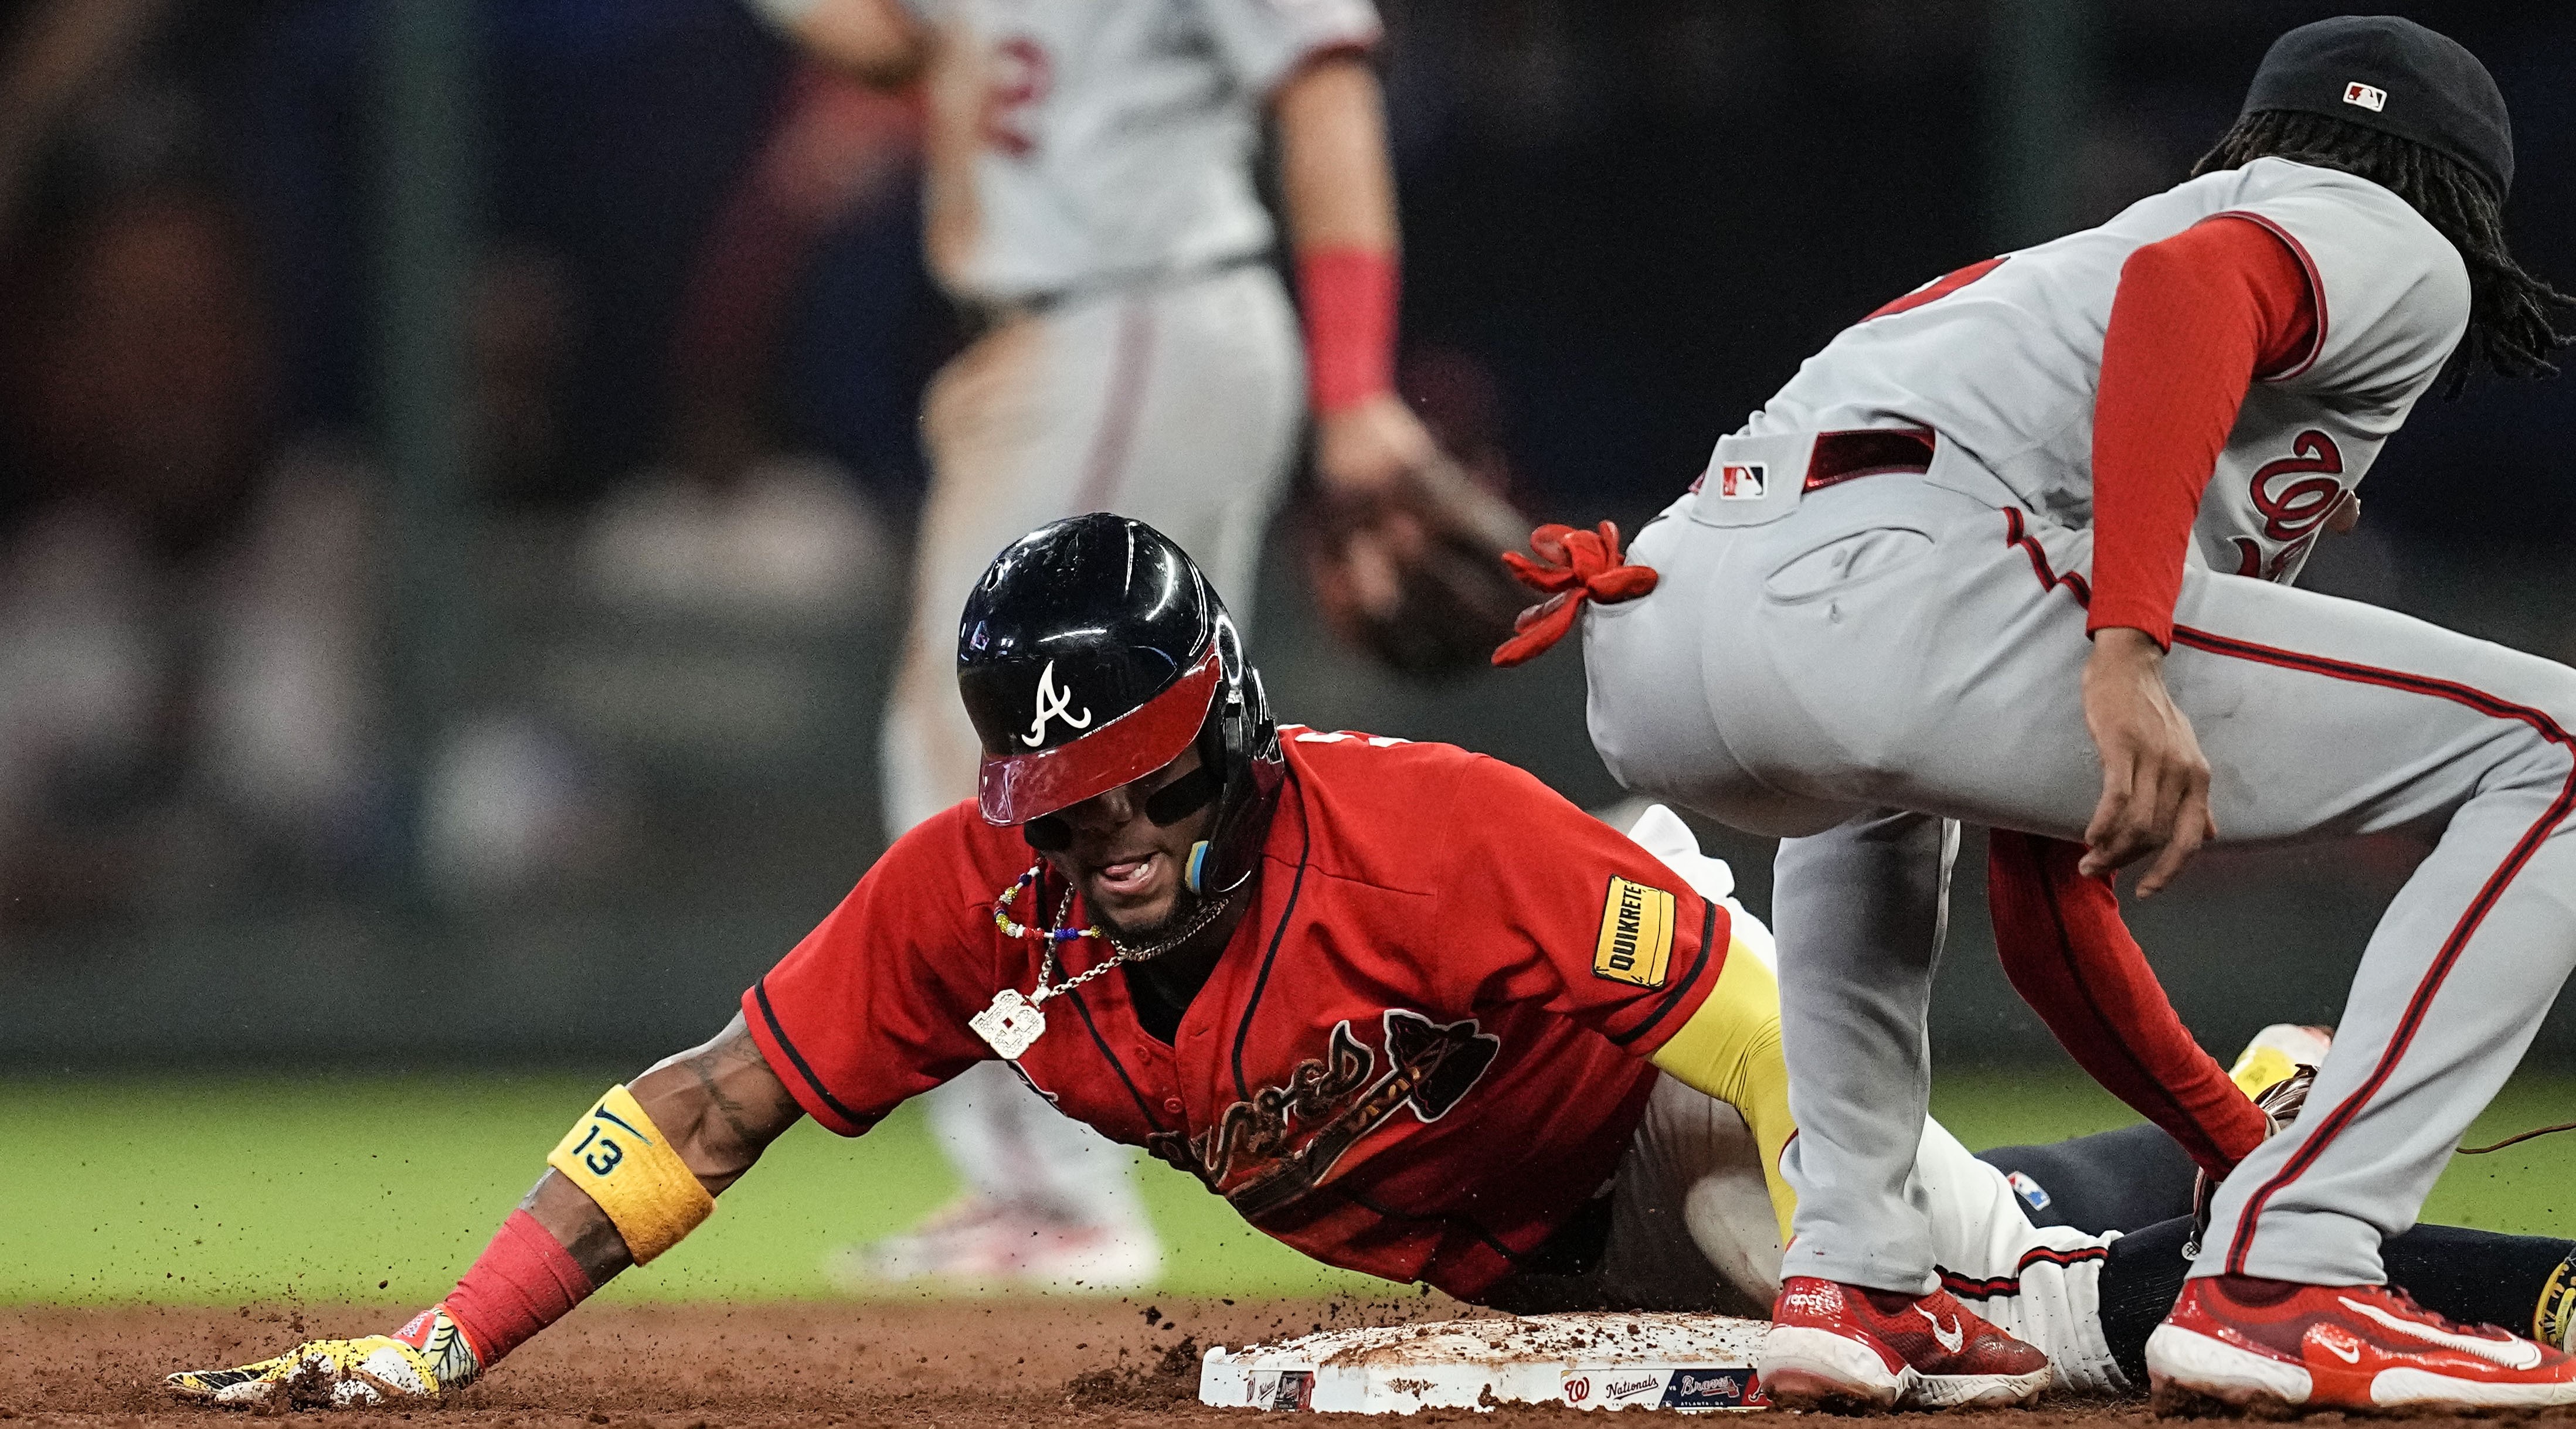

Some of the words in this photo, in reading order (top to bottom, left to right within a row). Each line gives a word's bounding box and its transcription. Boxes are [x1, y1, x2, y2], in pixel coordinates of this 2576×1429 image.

[1022, 660, 1091, 747] A
[1609, 884, 1642, 971] QUIKRETE
[572, 1124, 623, 1176] 13
[1565, 1377, 1589, 1403] W
[1606, 1374, 1659, 1399] Nationals
